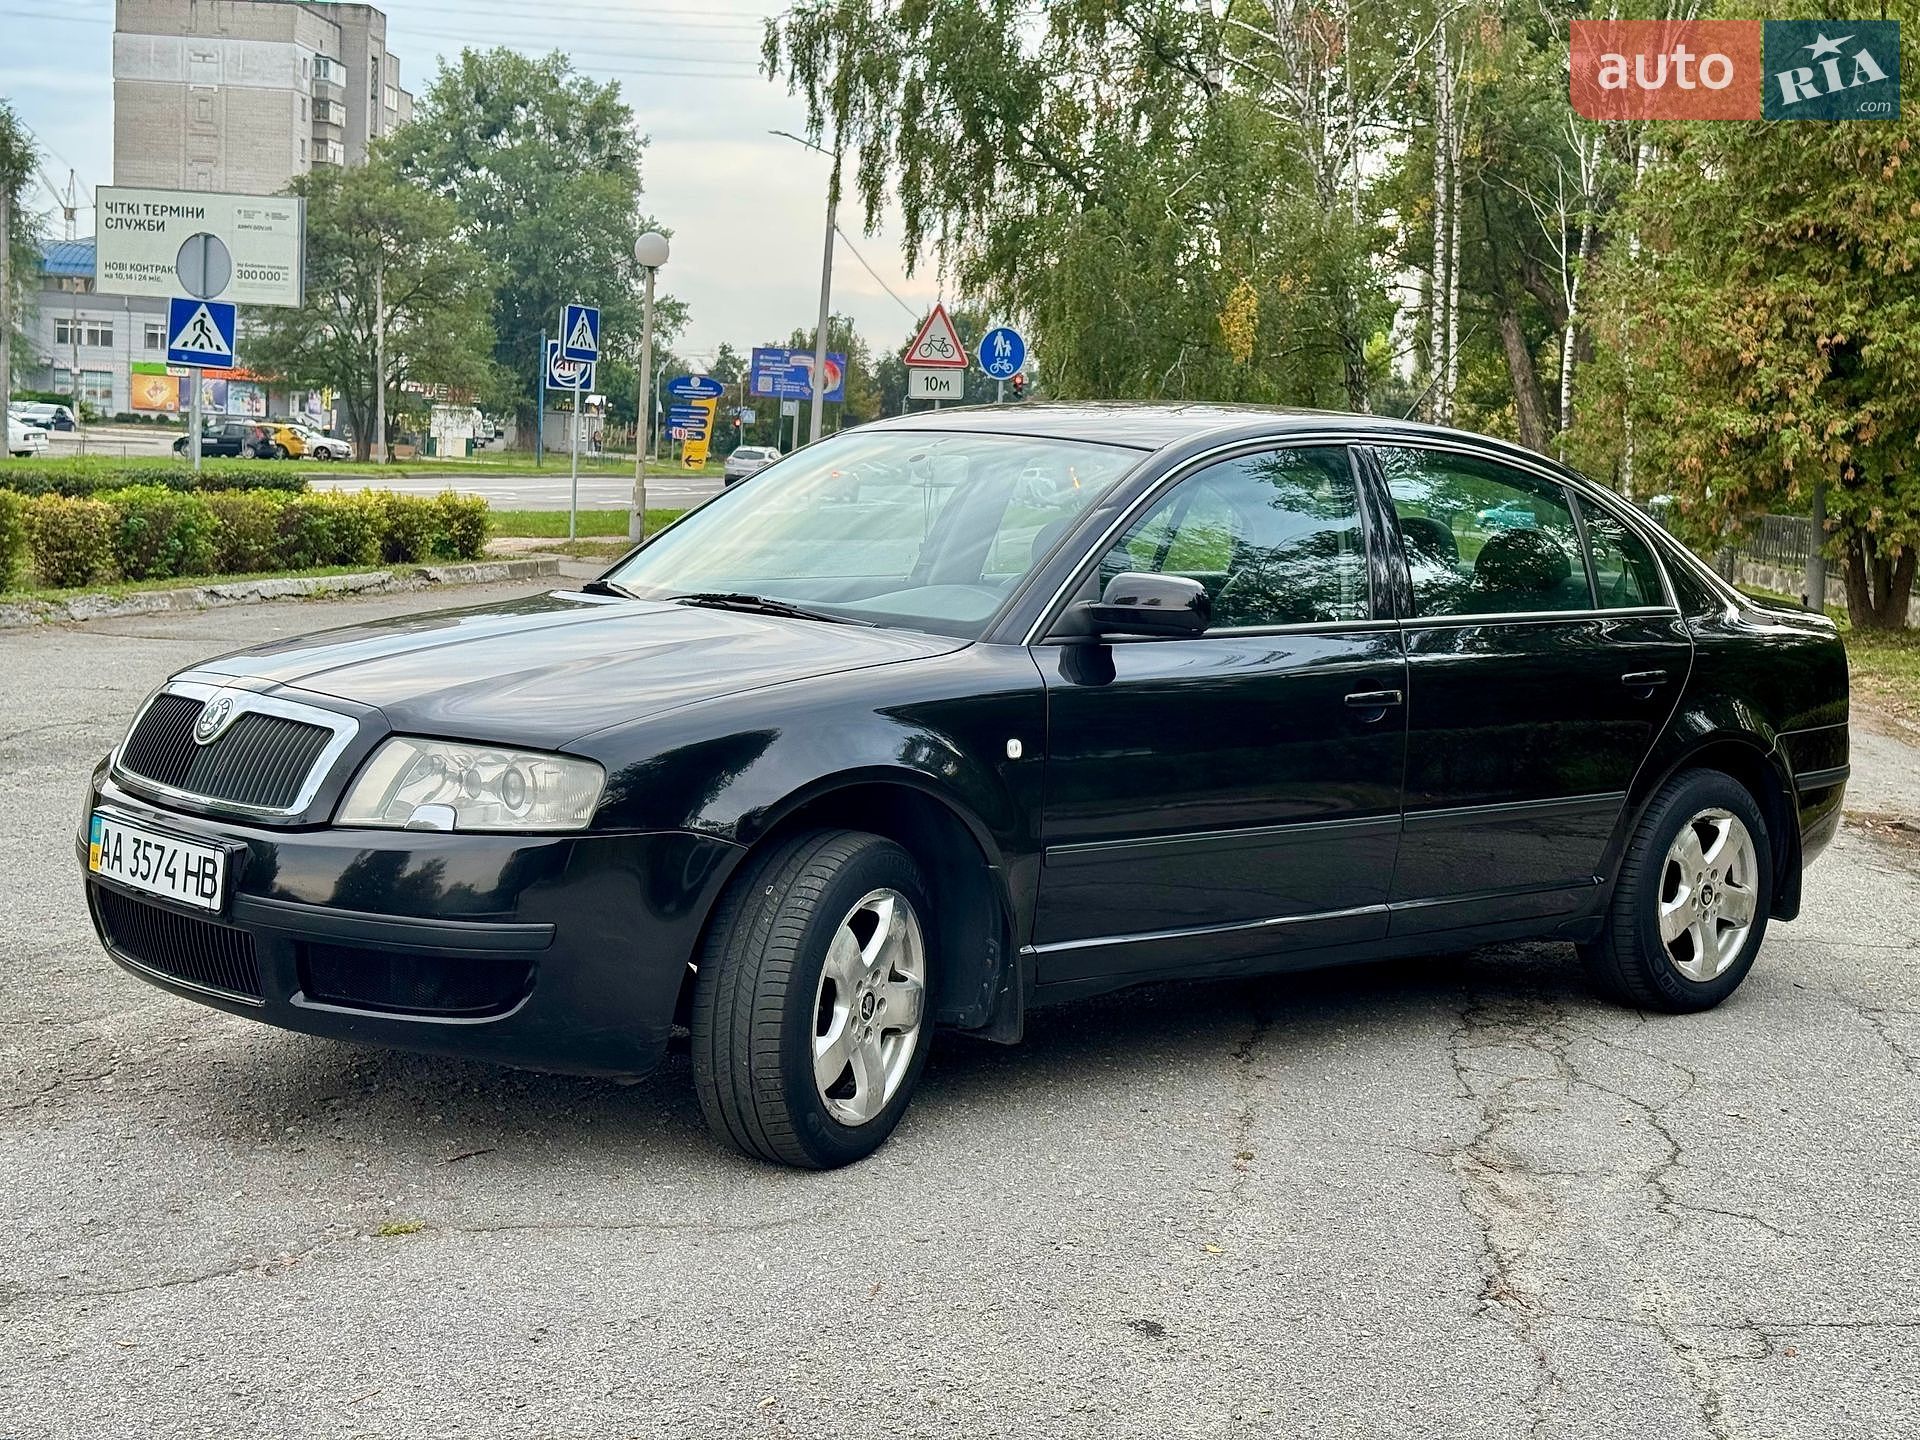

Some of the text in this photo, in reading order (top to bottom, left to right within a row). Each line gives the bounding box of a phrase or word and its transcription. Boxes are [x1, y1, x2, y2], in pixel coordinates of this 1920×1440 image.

[105, 201, 205, 219] ЧІТКІ ТЕРМІНИ
[105, 217, 165, 232] СЛУЖБИ
[104, 261, 128, 271] НОВІ
[100, 828, 218, 899] AA 3574 HB
